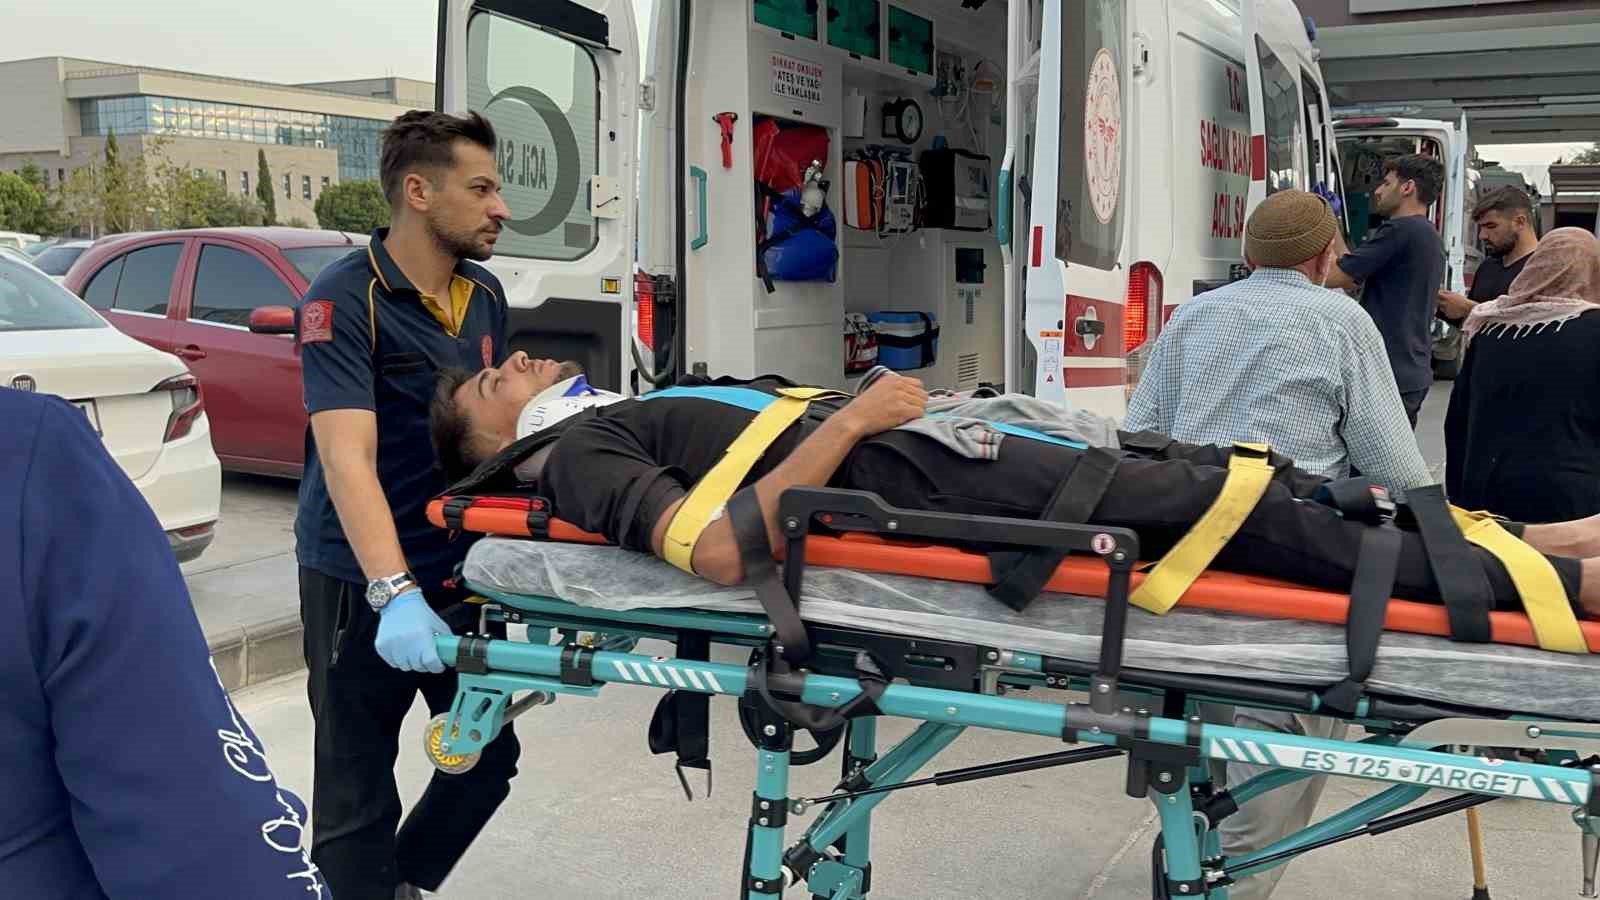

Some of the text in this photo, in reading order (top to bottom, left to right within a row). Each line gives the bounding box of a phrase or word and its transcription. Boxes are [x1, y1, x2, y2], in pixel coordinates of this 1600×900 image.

[1233, 195, 1246, 239] SA
[1301, 750, 1529, 796] ES 125 TARGET
